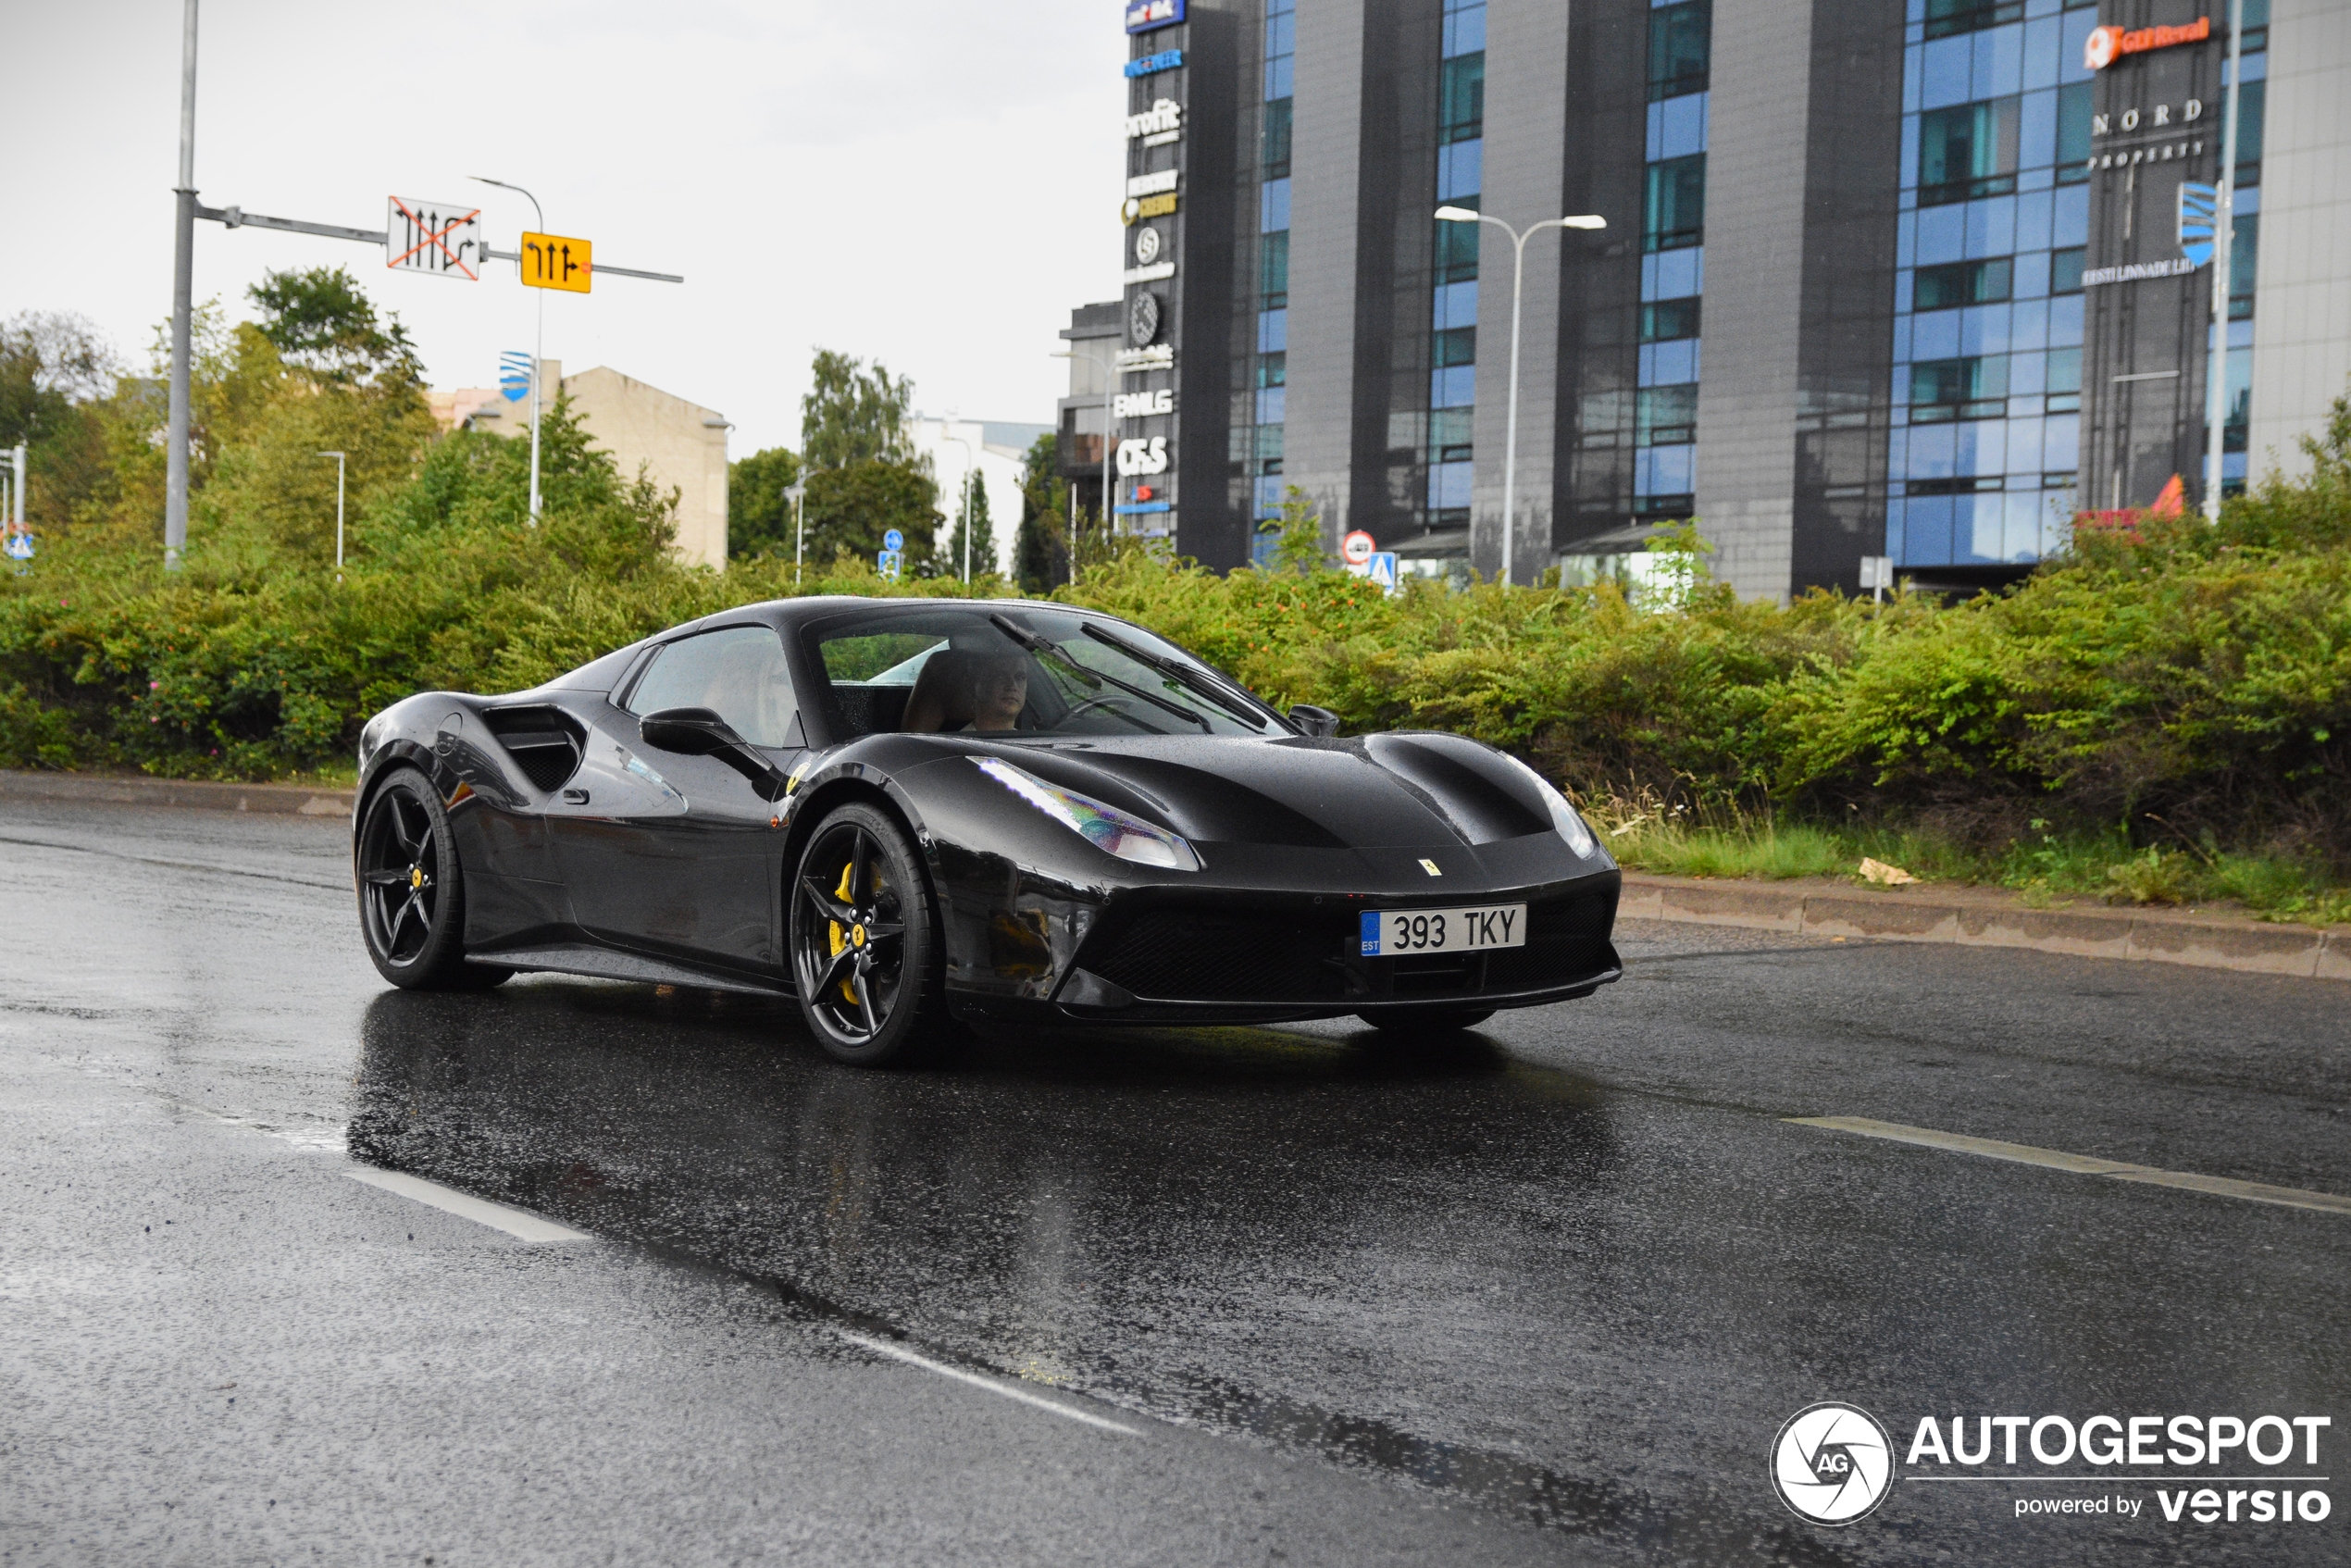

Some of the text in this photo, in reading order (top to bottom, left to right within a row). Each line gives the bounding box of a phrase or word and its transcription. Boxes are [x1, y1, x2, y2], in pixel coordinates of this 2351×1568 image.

[2092, 98, 2202, 136] NORD
[2087, 141, 2203, 171] PROPERTY
[1362, 940, 1379, 952] EST
[1394, 909, 1516, 950] 393 TKY
